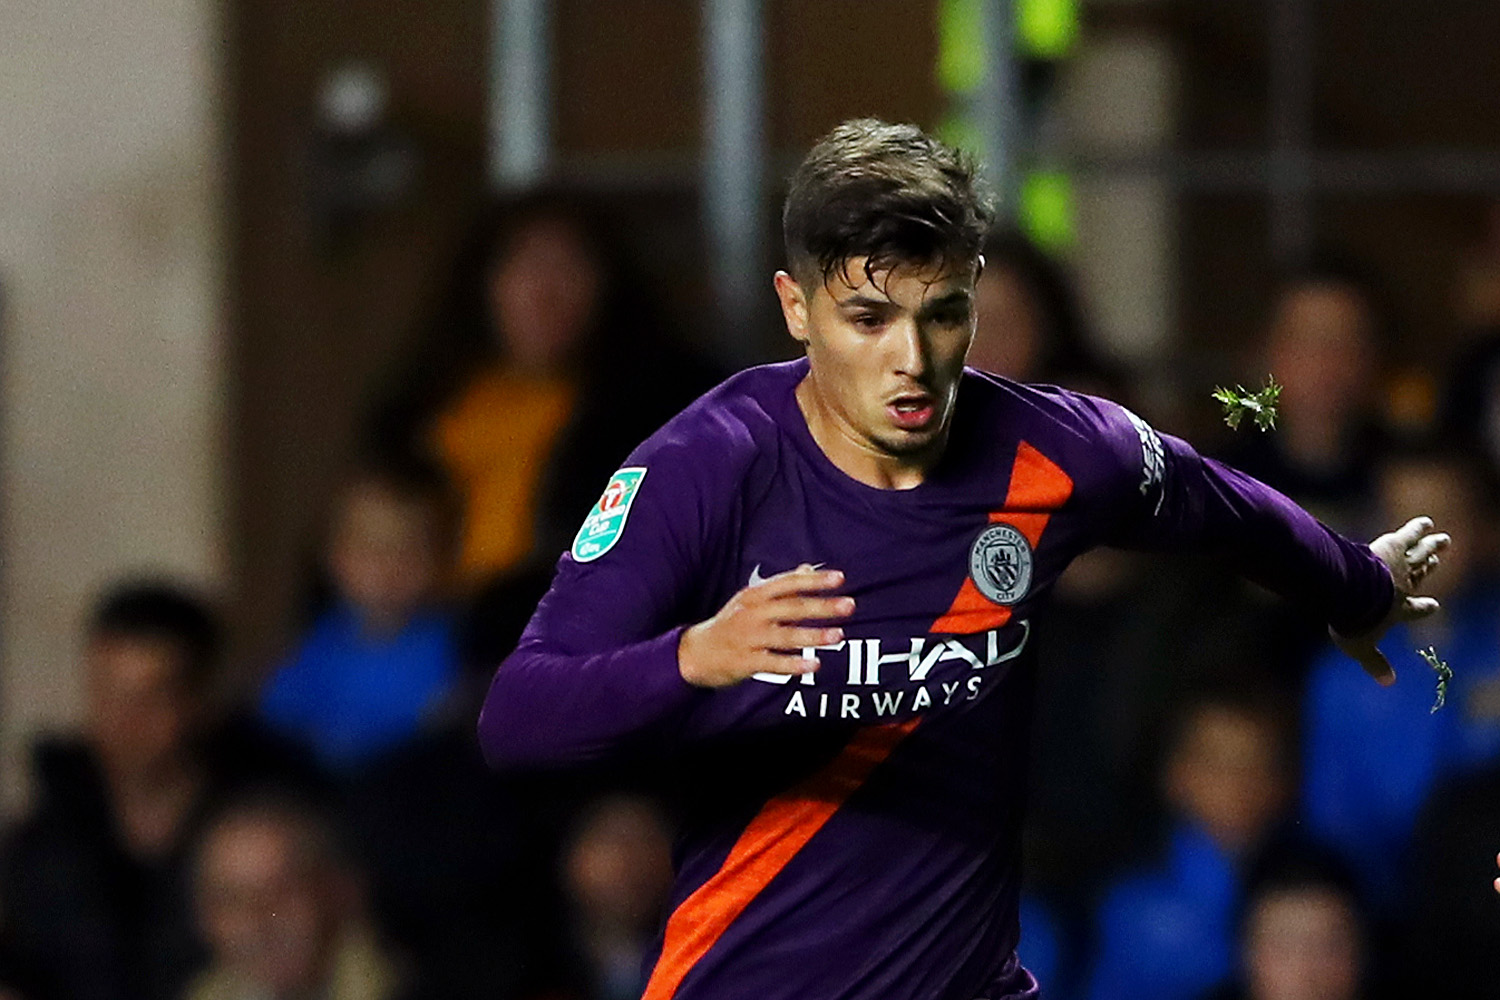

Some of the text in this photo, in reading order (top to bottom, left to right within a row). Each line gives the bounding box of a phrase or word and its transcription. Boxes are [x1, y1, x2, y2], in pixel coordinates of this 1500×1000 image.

[996, 591, 1015, 600] CITY
[752, 619, 1030, 686] TIHAD
[784, 676, 982, 719] AIRWAYS
